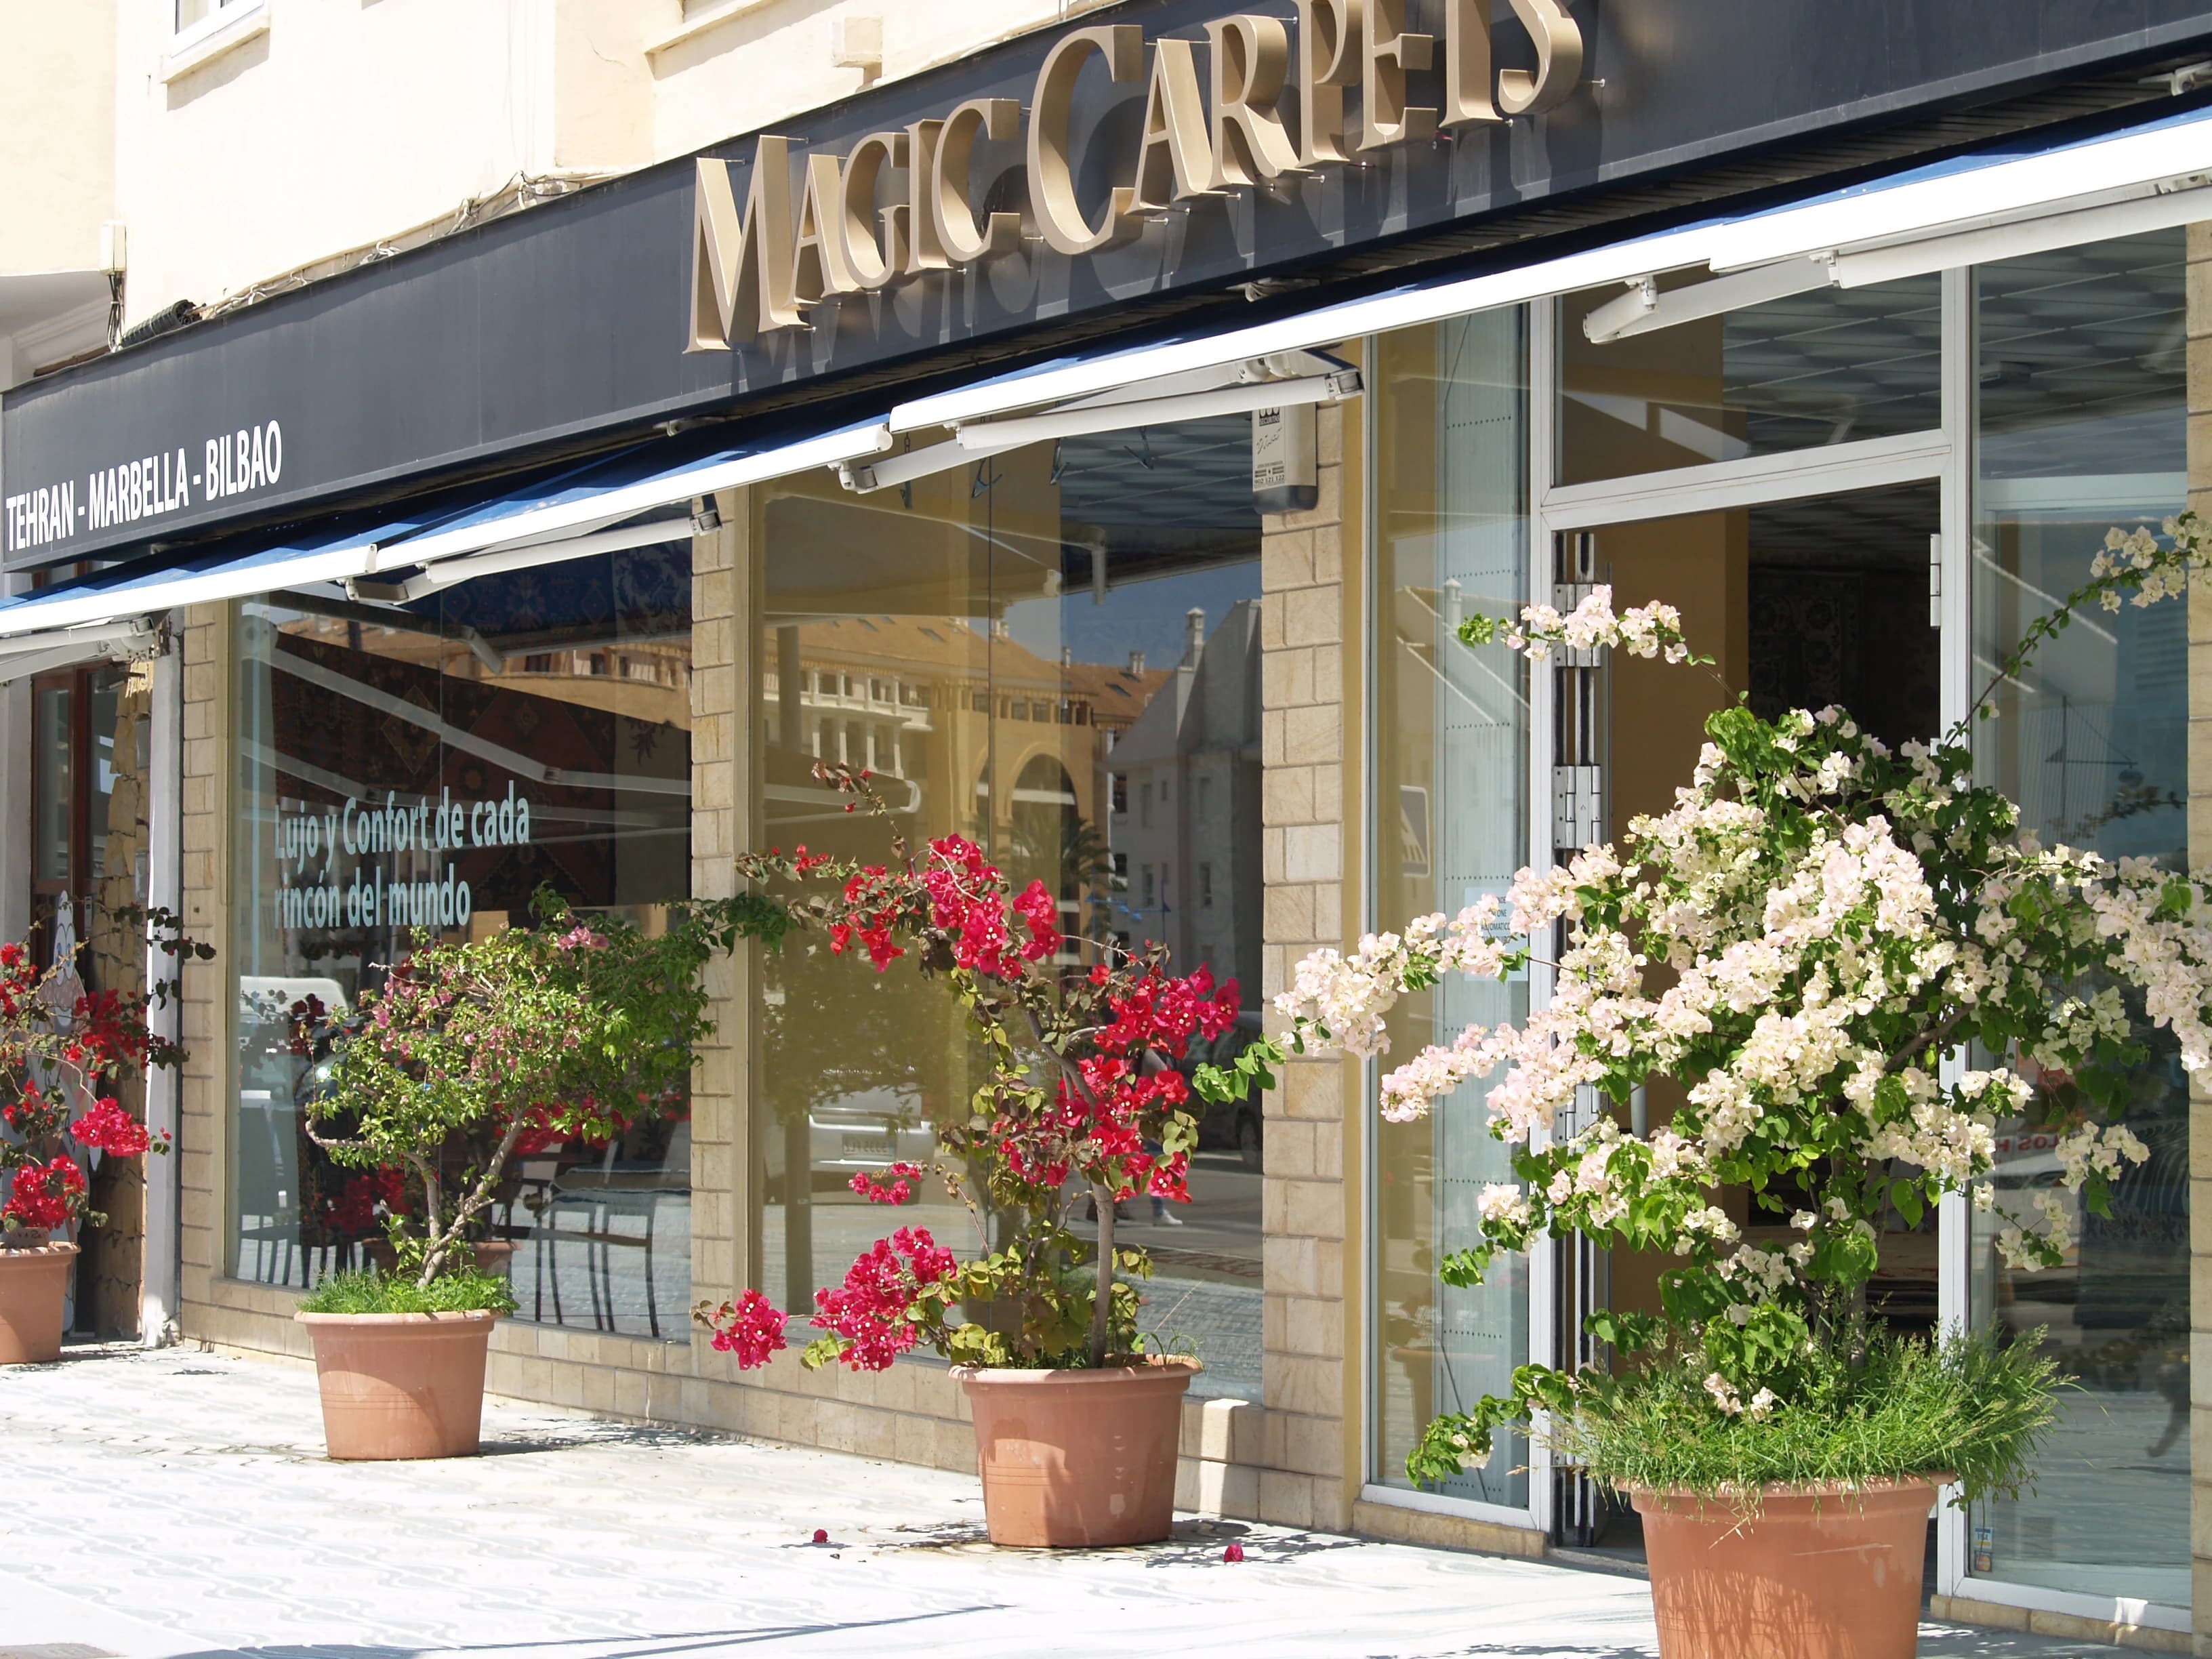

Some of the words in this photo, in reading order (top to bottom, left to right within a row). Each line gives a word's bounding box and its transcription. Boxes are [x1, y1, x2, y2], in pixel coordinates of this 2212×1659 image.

[682, 98, 1019, 354] MAGIC
[6, 480, 75, 552] TEHRAN
[89, 448, 189, 531] MARBELLA
[206, 419, 283, 501] BILBAO
[274, 800, 319, 874] Lujo
[325, 813, 337, 873] y
[343, 790, 428, 855] Confort
[435, 786, 464, 848] de
[471, 779, 530, 847] cada
[274, 869, 340, 929] rincón
[347, 866, 381, 927] del
[388, 863, 470, 926] mundo
